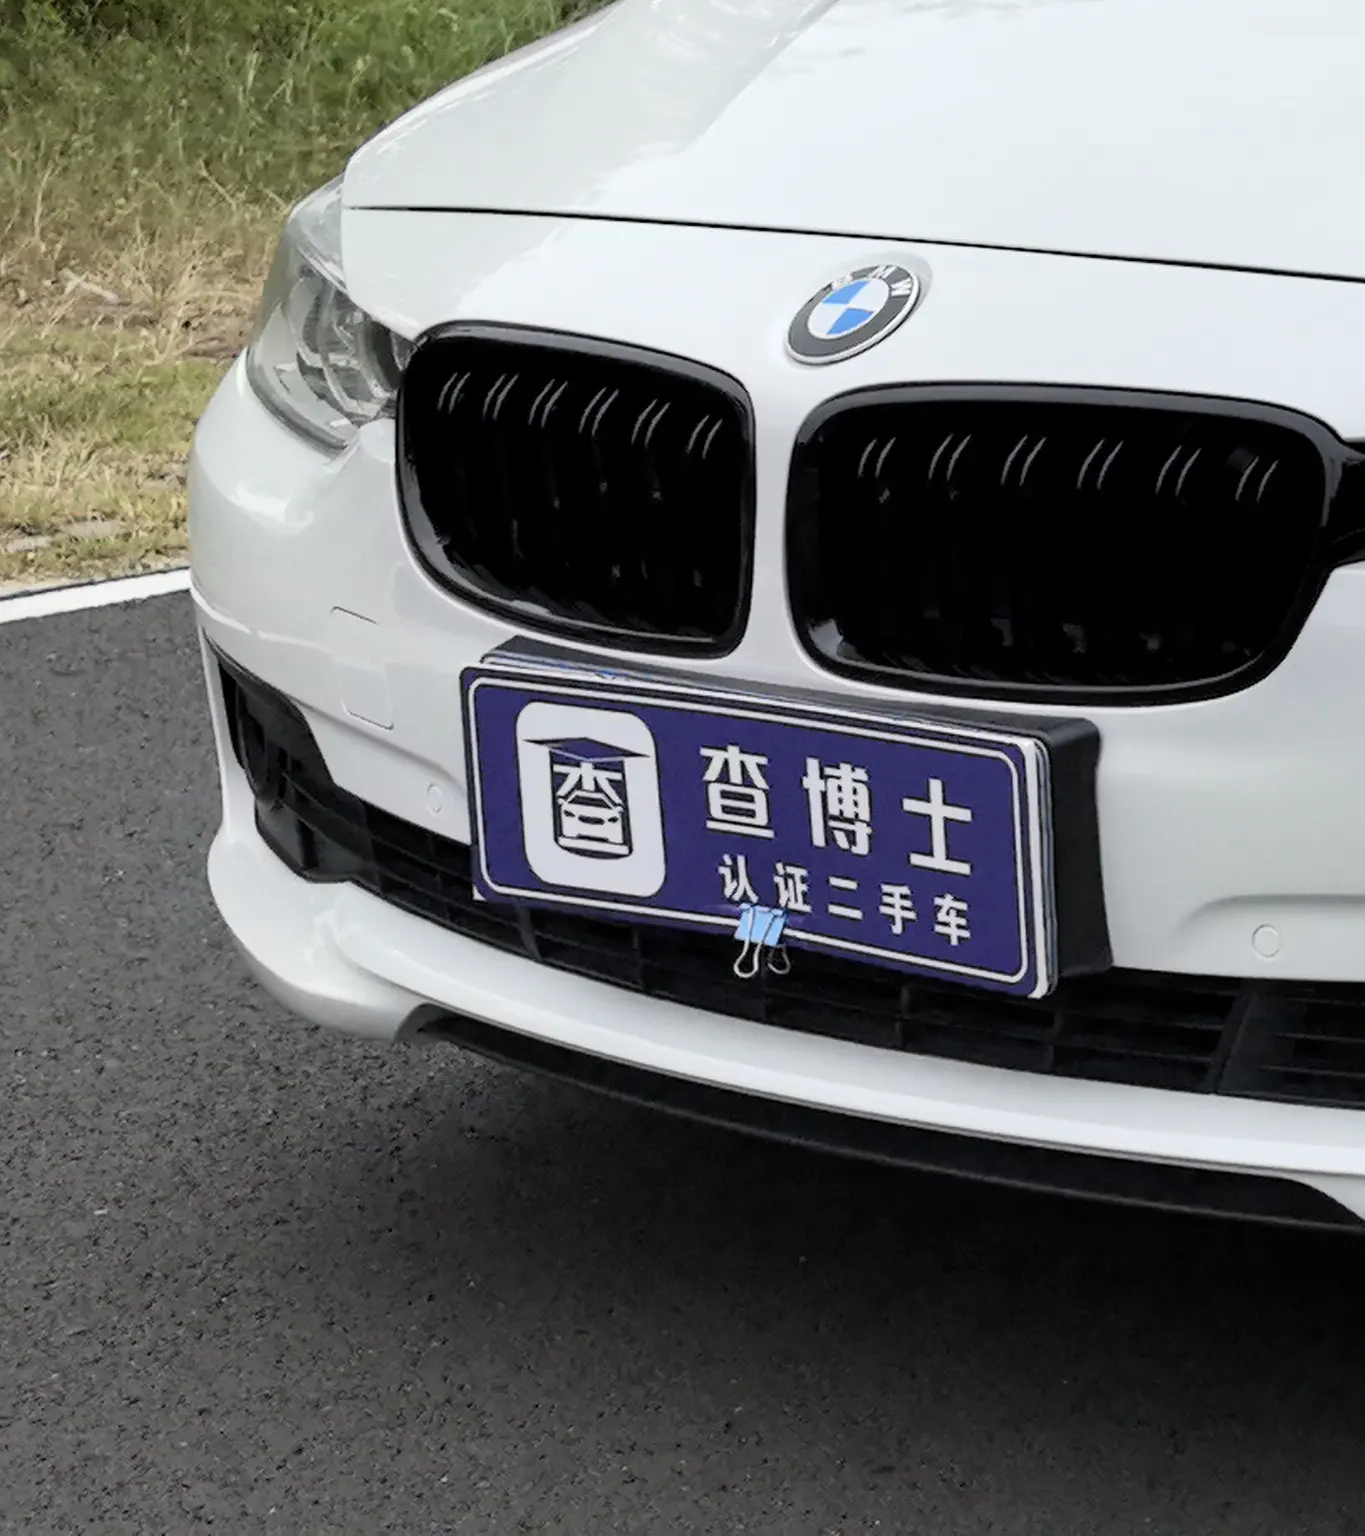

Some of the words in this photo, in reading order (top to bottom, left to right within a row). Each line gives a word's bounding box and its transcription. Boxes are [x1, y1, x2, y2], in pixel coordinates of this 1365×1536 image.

[700, 745, 971, 875] 查博士
[718, 853, 971, 946] 认证二手车
